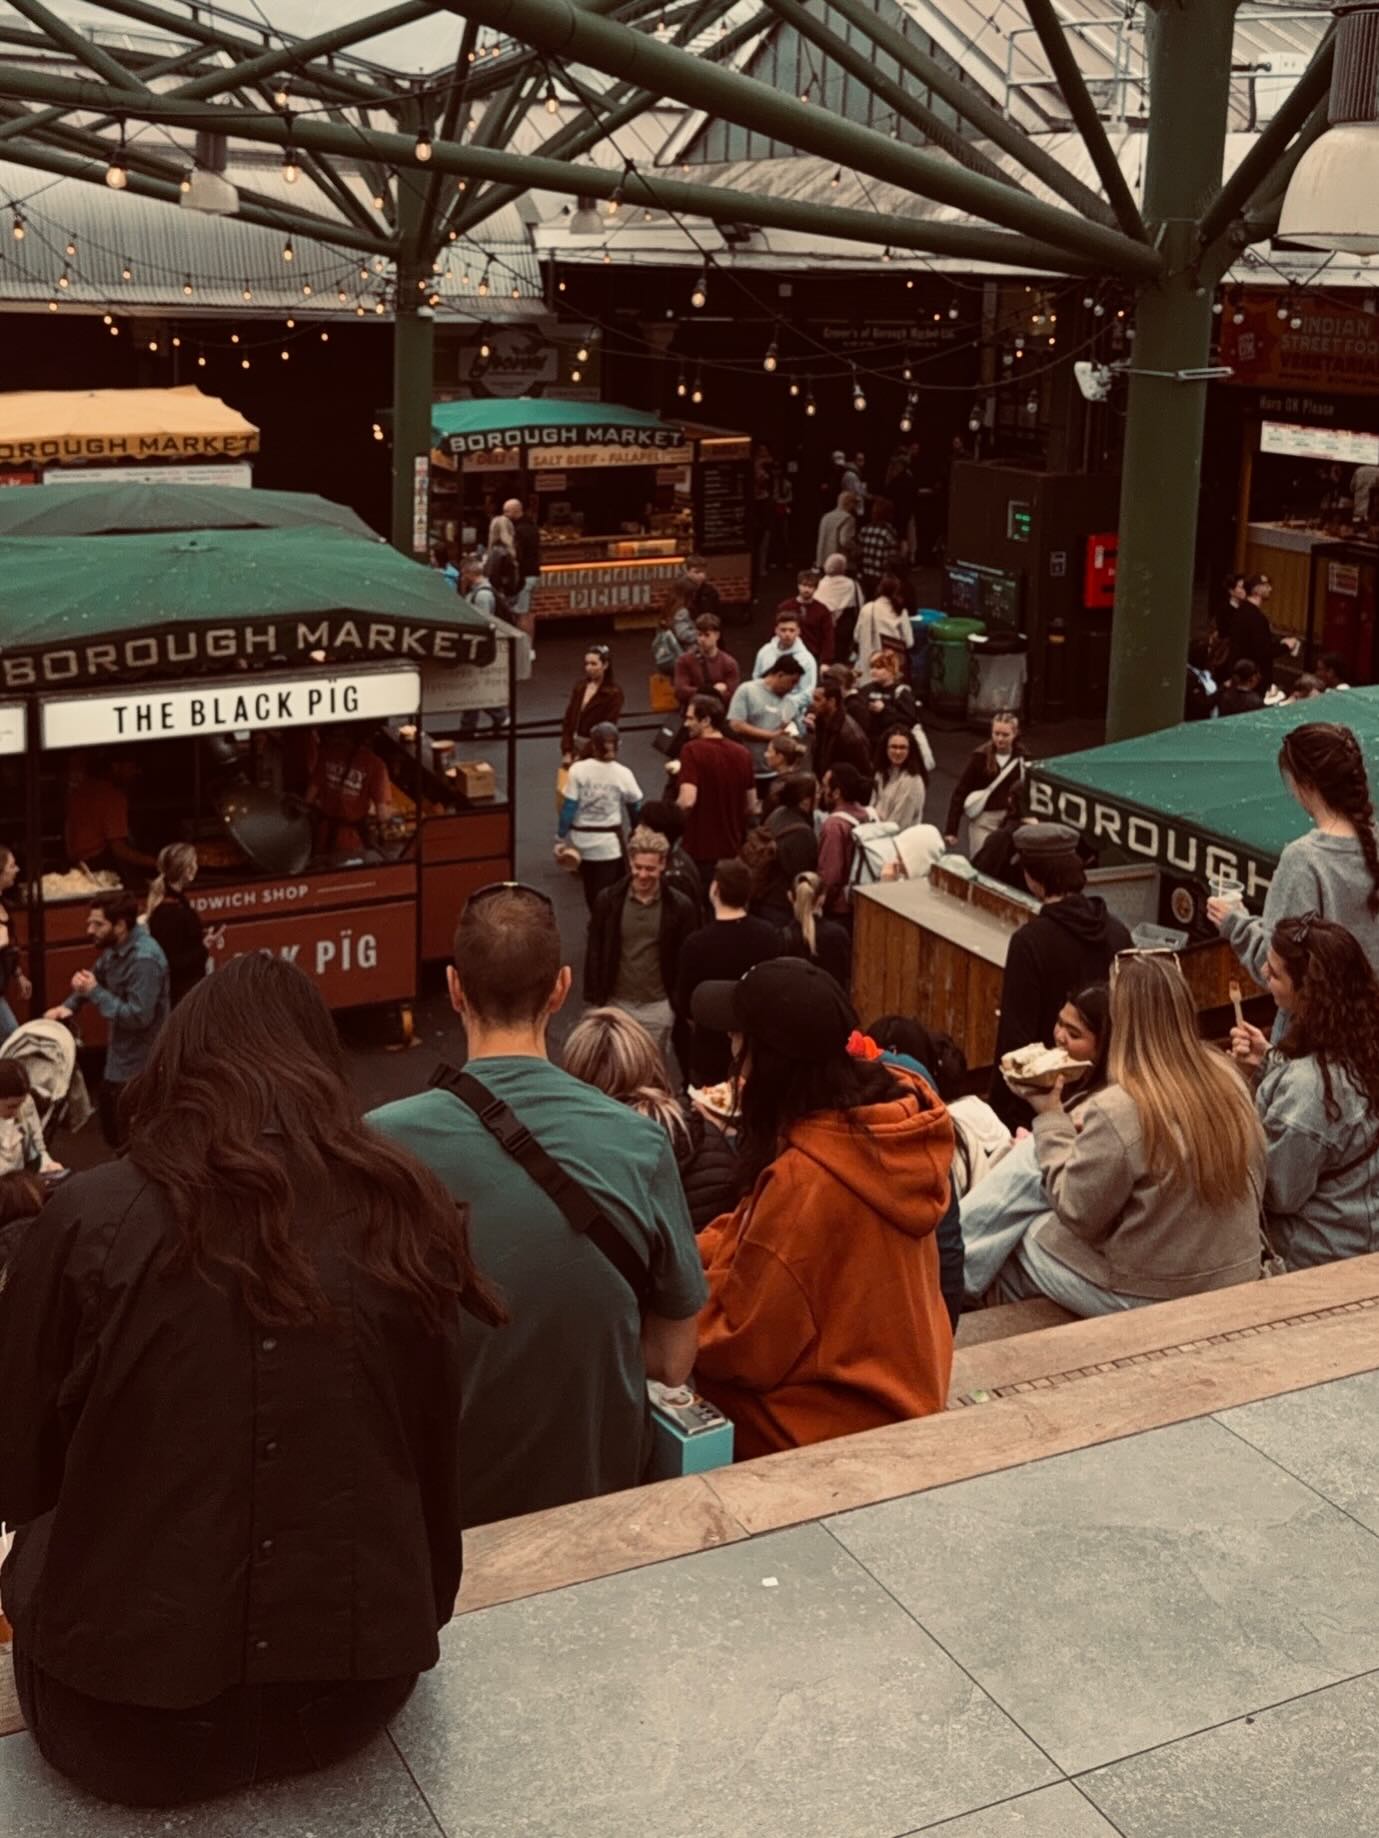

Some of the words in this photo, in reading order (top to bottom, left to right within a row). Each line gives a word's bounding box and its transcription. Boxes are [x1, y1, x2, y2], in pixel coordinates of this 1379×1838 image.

[1301, 316, 1370, 338] INDIAN
[1280, 333, 1343, 354] STREET
[139, 434, 257, 453] MARKET
[450, 427, 578, 452] BOROUGH
[586, 427, 682, 447] MARKET
[533, 454, 562, 466] SALT
[566, 453, 596, 465] BEEF
[3, 624, 276, 687] BOROUGH
[297, 620, 488, 661] MARKET
[112, 702, 175, 735] THE
[190, 691, 294, 727] BLACK
[308, 680, 359, 715] PÏG
[1029, 780, 1271, 898] BOROUGH
[260, 883, 310, 905] SHOP
[314, 927, 378, 976] PÏG
